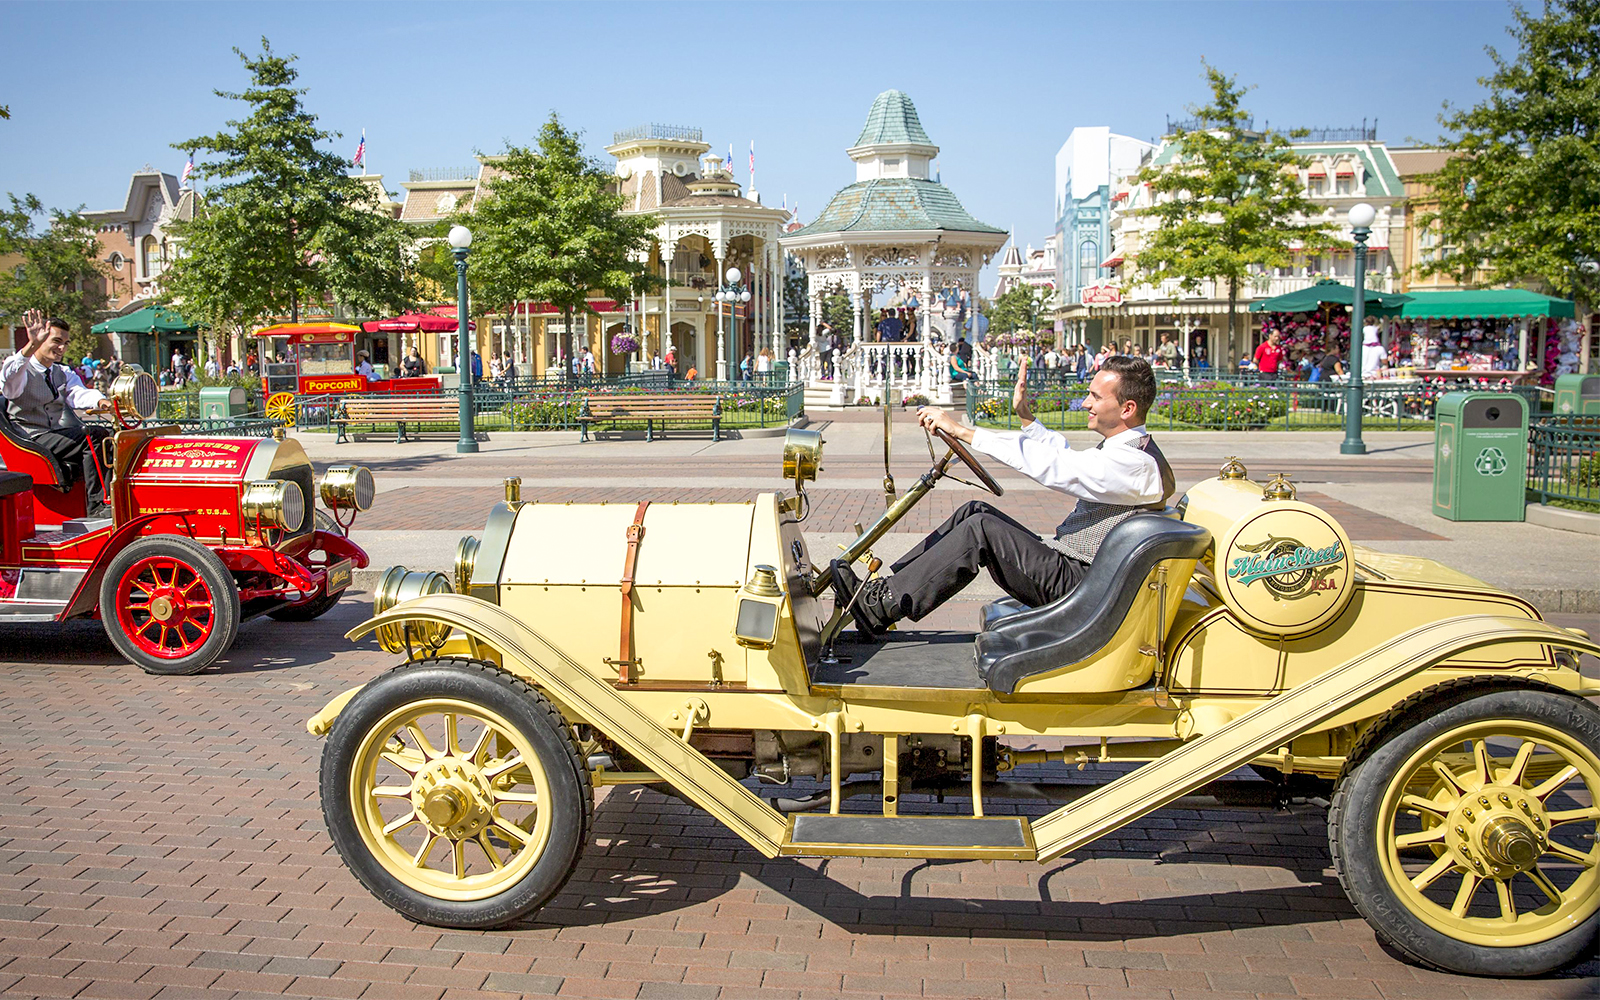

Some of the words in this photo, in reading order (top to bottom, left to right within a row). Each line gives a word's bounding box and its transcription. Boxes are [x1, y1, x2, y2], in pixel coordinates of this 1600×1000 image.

[308, 380, 358, 391] POPCORN
[155, 442, 240, 453] VOLUNTEER
[142, 459, 185, 468] FIRE
[190, 459, 238, 468] DEPT.
[1227, 552, 1285, 578] Main
[1285, 539, 1345, 569] Street
